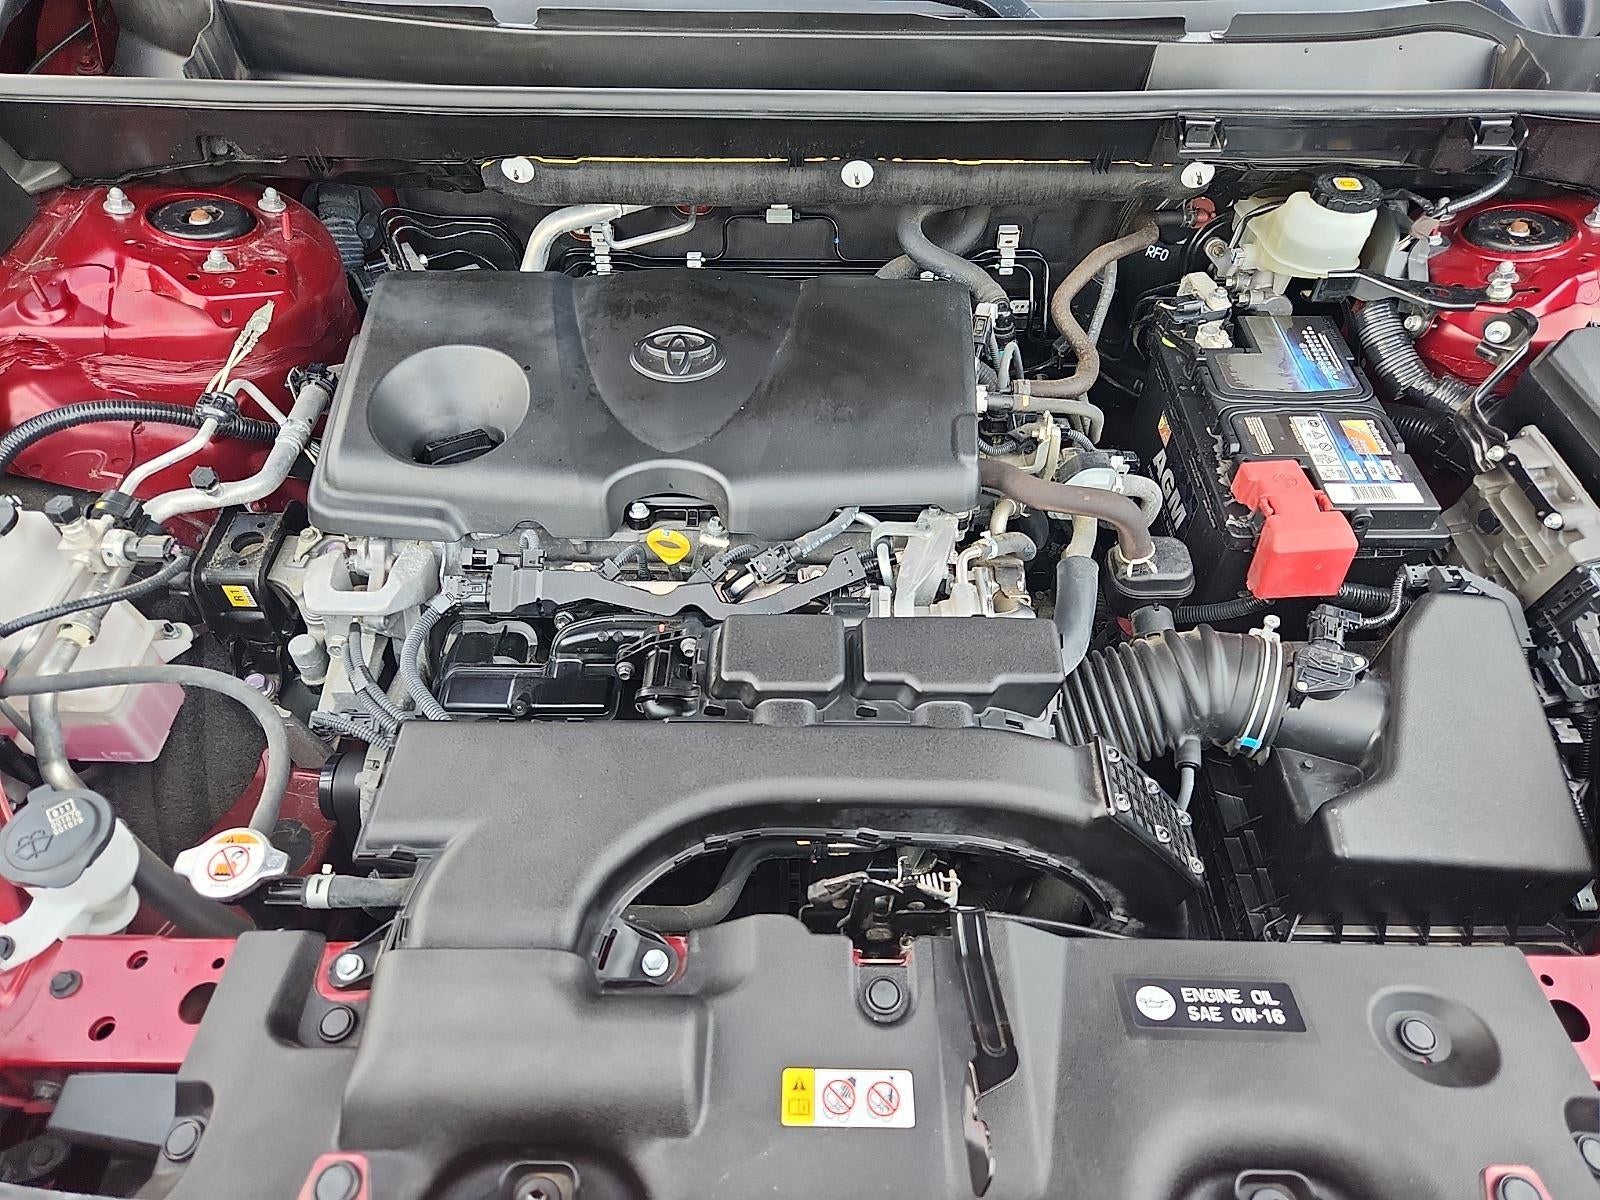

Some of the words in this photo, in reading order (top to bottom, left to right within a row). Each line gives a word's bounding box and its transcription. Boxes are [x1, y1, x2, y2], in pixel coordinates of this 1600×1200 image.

[1152, 448, 1187, 531] AGM
[1180, 987, 1244, 1005] ENGINE
[1250, 989, 1281, 1006] OIL
[1187, 1006, 1224, 1023] SAE
